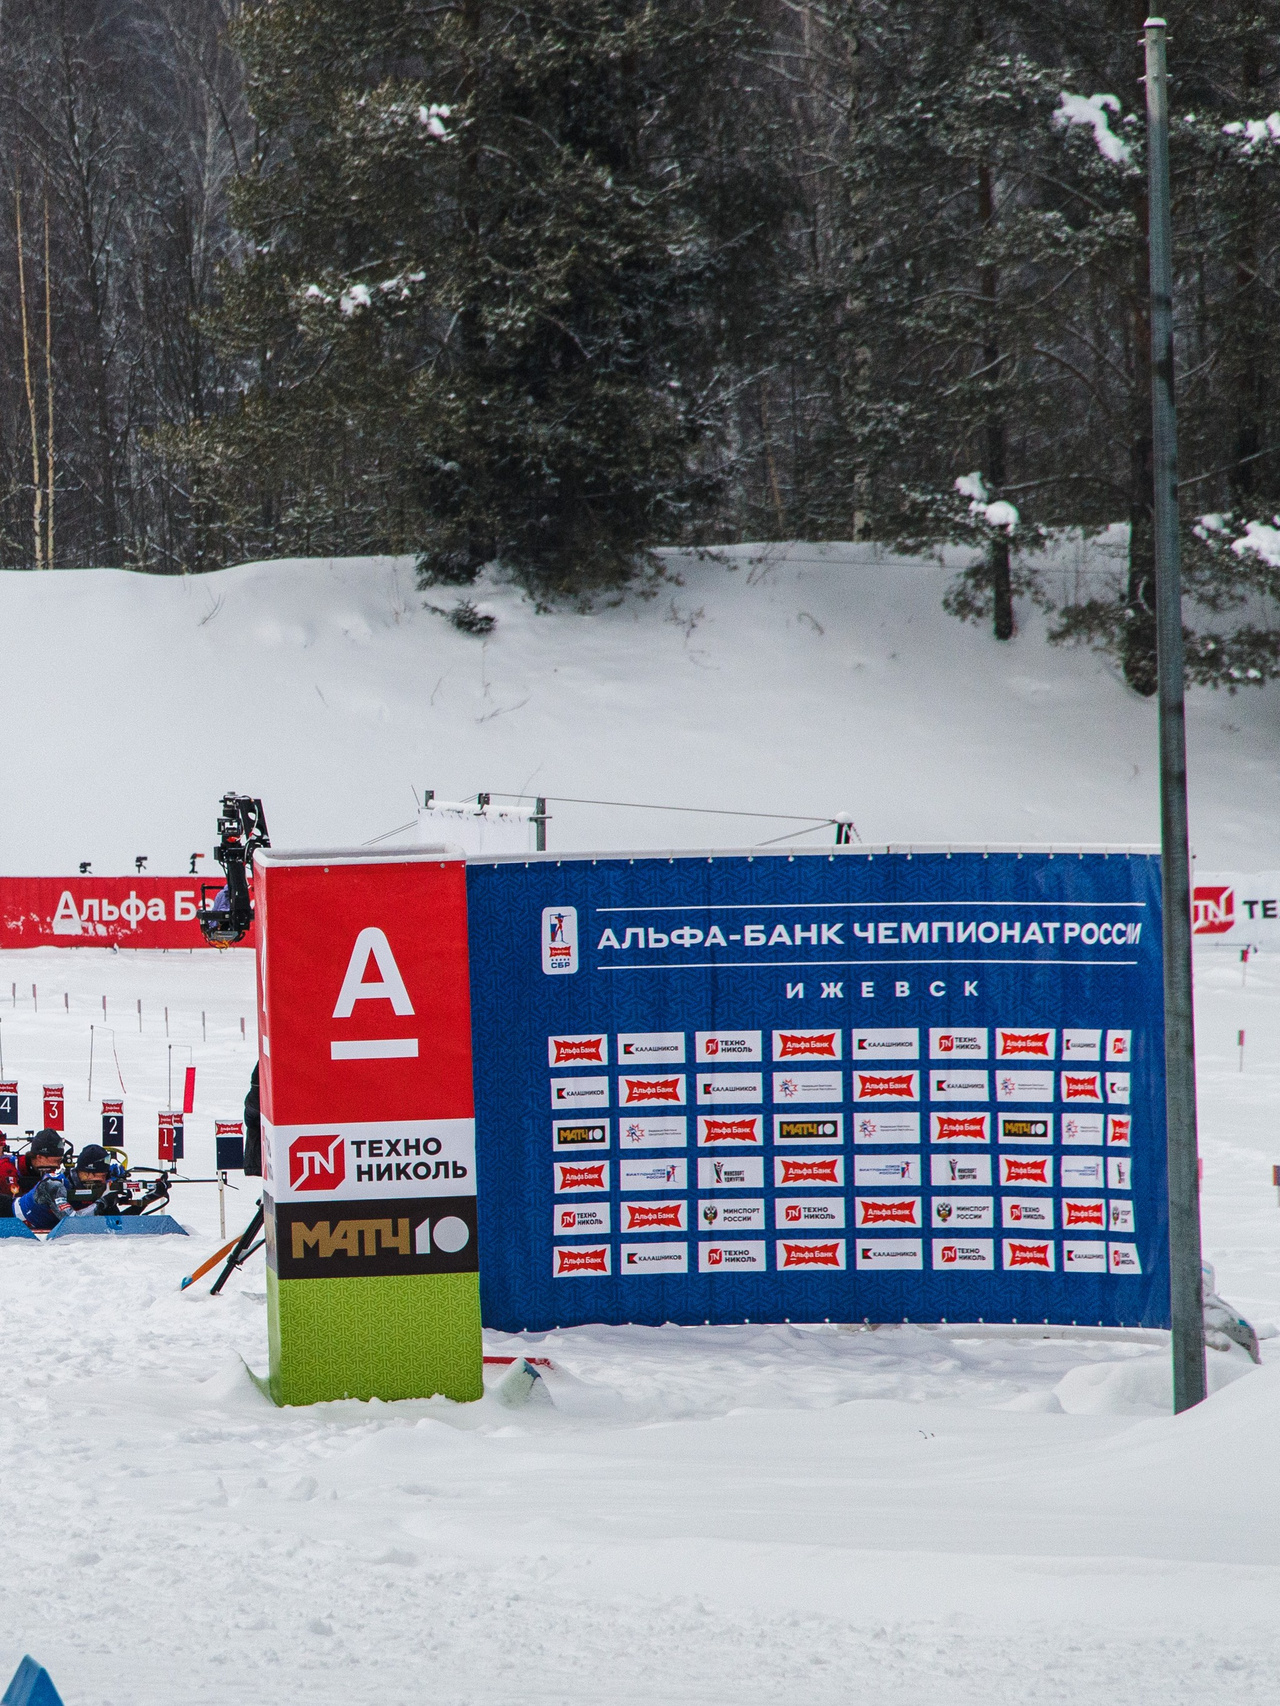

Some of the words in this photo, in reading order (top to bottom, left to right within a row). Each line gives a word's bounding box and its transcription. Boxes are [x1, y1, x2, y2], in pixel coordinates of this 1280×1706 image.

[53, 890, 166, 930] Альфа
[597, 923, 844, 949] АЛЬФА-БАНК
[853, 921, 1061, 945] ЧЕМПИОНАТ
[1064, 922, 1142, 945] РОССИИ
[551, 961, 570, 969] СБР
[332, 926, 416, 1018] А
[786, 1041, 810, 1049] Альфа
[1006, 1040, 1025, 1048] Альфа
[560, 1045, 580, 1055] Альфа
[581, 1046, 597, 1054] Банк
[632, 1086, 656, 1095] Альфа
[865, 1082, 888, 1090] Альфа
[0, 1097, 11, 1113] 4
[49, 1102, 58, 1118] 3
[109, 1117, 117, 1134] 2
[943, 1123, 963, 1131] Альфа
[964, 1123, 981, 1131] Банк
[163, 1129, 168, 1147] 1
[350, 1137, 442, 1158] ТЕХНО
[356, 1161, 468, 1183] НИКОЛЬ
[788, 1167, 812, 1176] Альфа
[1010, 1167, 1027, 1175] Альфа
[565, 1173, 583, 1181] Альфа
[584, 1172, 599, 1180] Банк
[634, 1212, 657, 1221] Альфа
[867, 1208, 891, 1216] Альфа
[790, 1251, 813, 1259] Альфа
[563, 1257, 585, 1266] Альфа
